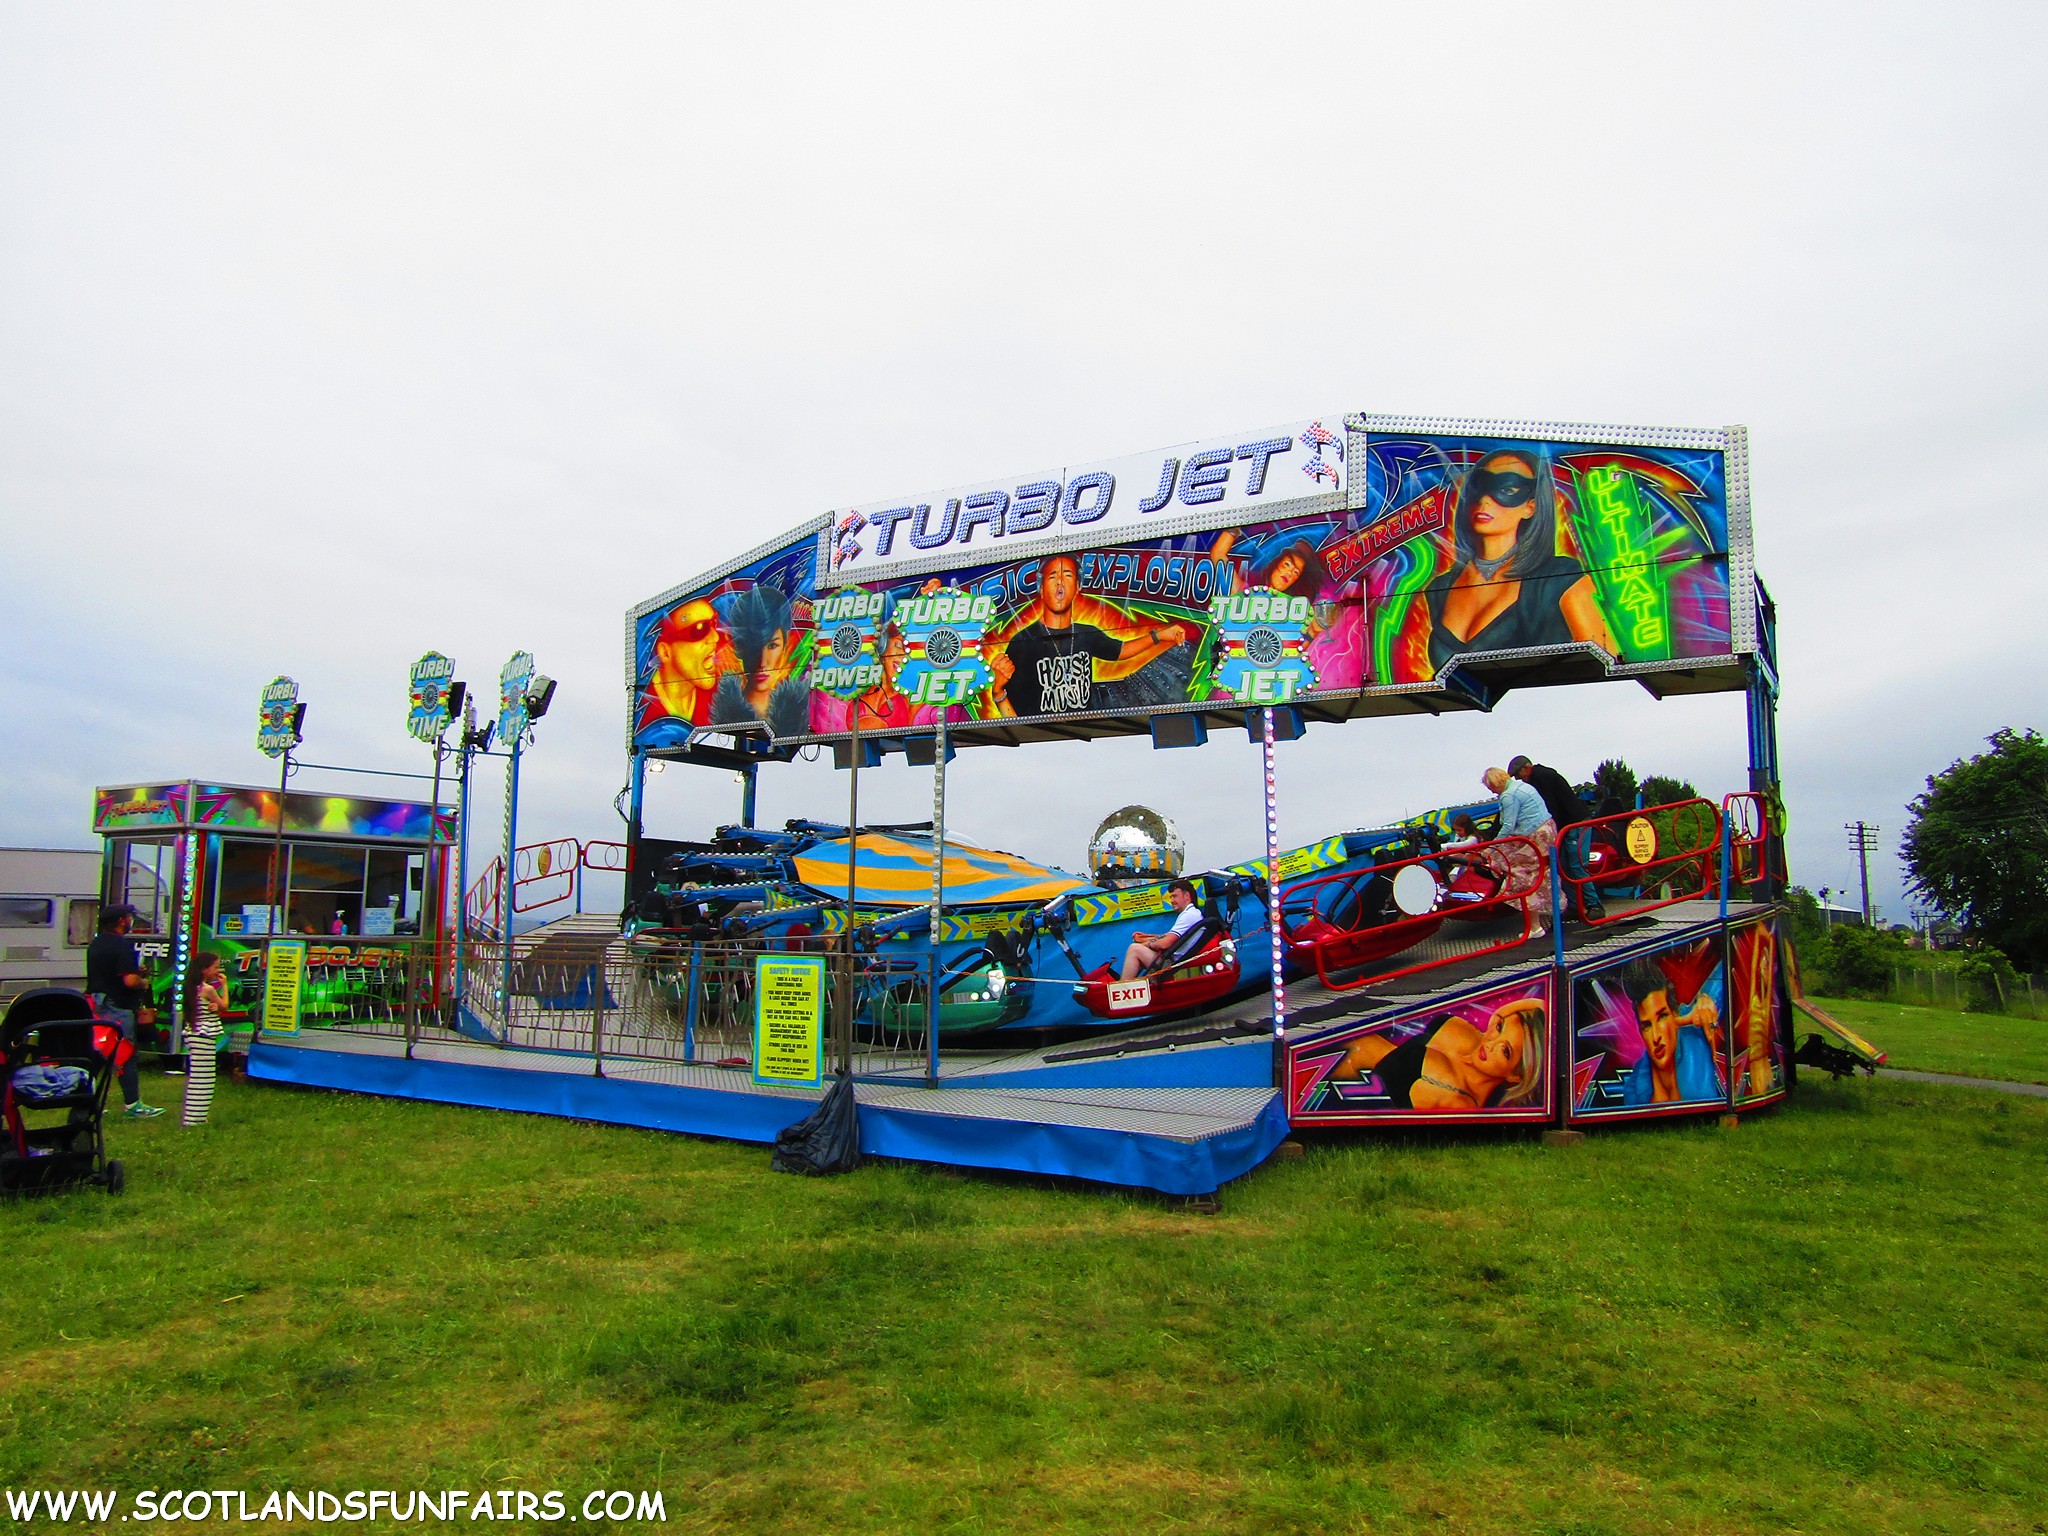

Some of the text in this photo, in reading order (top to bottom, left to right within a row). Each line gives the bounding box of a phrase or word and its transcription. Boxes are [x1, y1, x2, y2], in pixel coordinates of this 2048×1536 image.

[868, 435, 1293, 557] TURBO JET
[1325, 496, 1439, 582] EXTREME
[1588, 465, 1663, 648] ULTIMATE
[970, 553, 1236, 608] SIC EXPLOSION
[812, 593, 885, 621] TURBO
[897, 596, 993, 625] TURBO
[1213, 596, 1309, 622] TURBO
[410, 658, 455, 679] TURBO
[503, 653, 533, 681] TURBO
[810, 665, 884, 690] POWER
[1036, 651, 1090, 688] HOUSE
[263, 682, 299, 700] TURBO
[910, 670, 976, 703] JET
[1234, 671, 1300, 701] JET
[409, 714, 450, 738] TIME
[504, 717, 522, 744] JET
[258, 733, 295, 748] POWER
[235, 946, 403, 972] TBOJET
[1112, 987, 1146, 1002] EXIT
